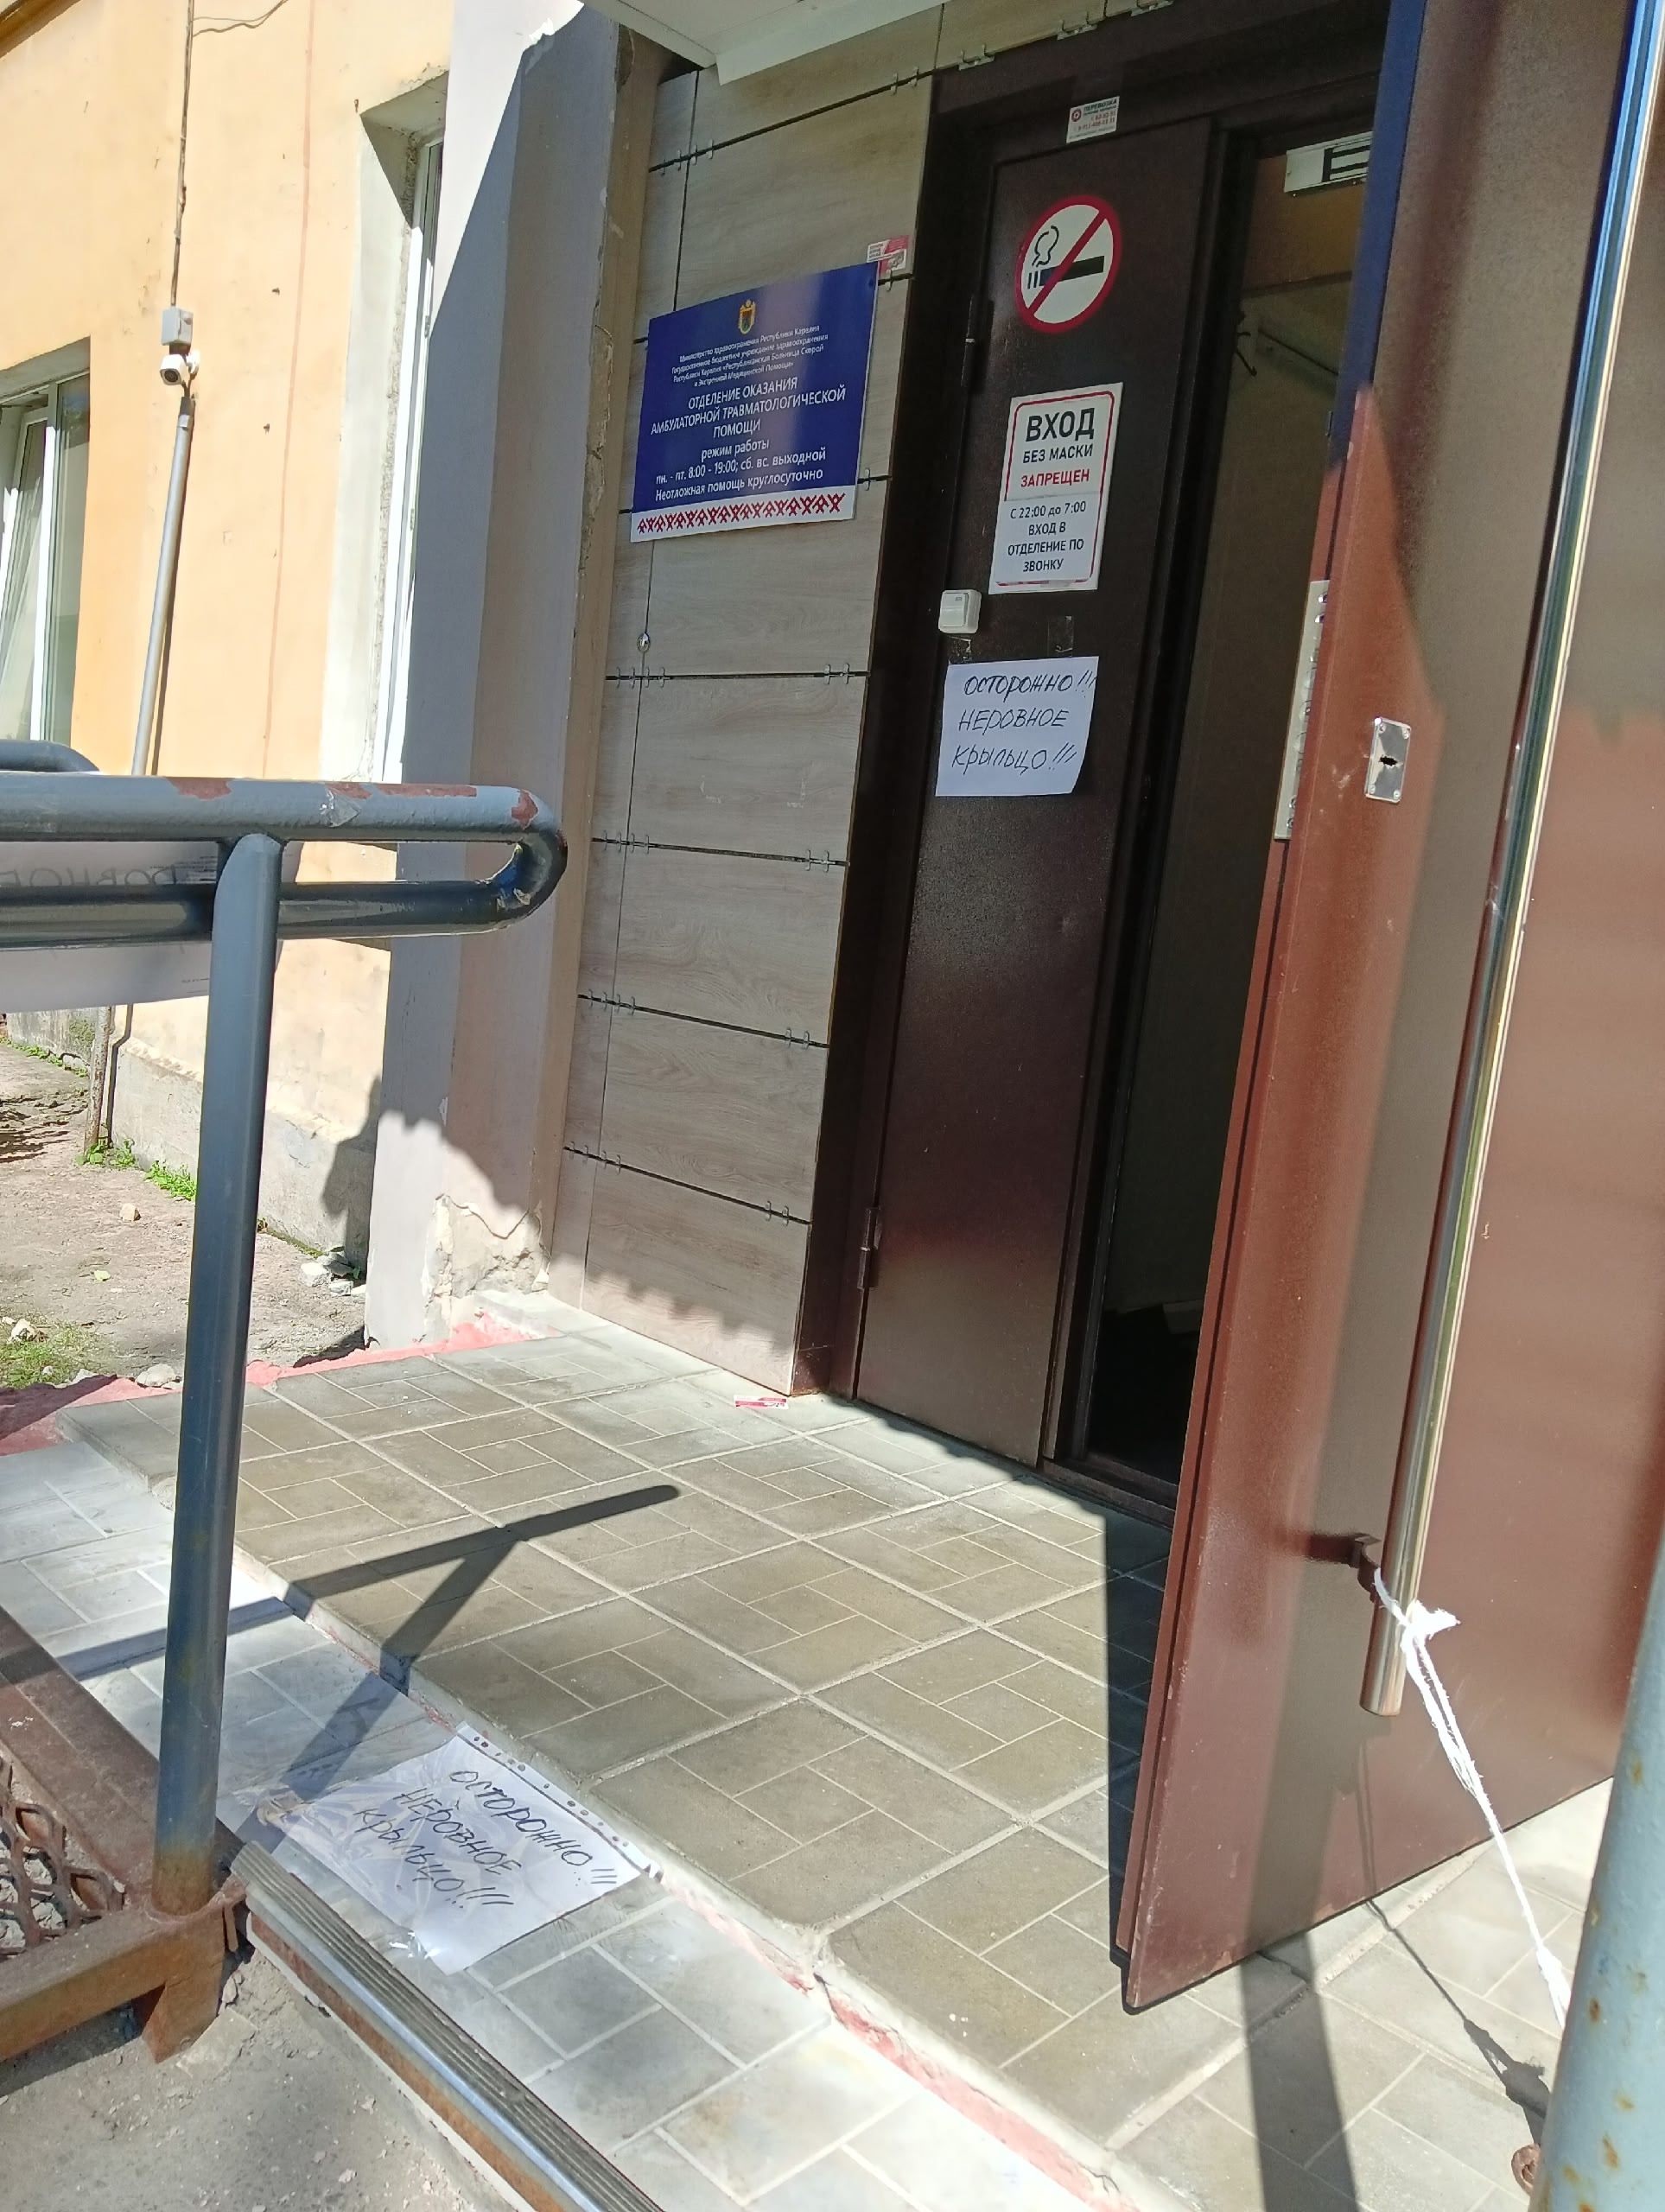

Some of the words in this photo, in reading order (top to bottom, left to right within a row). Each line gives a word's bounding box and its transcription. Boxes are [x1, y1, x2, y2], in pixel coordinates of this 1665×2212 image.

[688, 387, 741, 410] ОТДЕЛЕНИЕ
[742, 377, 798, 397] ОКАЗАНИЯ
[651, 406, 721, 435] АМБУЛАТОРНОЙ
[722, 384, 847, 418] ТРАВМАТОЛОГИЧЕСКОЙ
[713, 418, 761, 439] ПОМОЩИ
[1025, 407, 1095, 442] ВХОД
[701, 444, 733, 463] режим
[734, 437, 770, 456] работы
[1022, 448, 1045, 464] БЕЗ
[1049, 443, 1093, 462] МАСКИ
[655, 474, 668, 486] пн.
[675, 469, 687, 483] пт.
[688, 463, 706, 480] 8:00
[740, 456, 754, 472] сб.
[756, 457, 770, 470] вс.
[772, 447, 826, 467] выходной
[1020, 468, 1090, 488] ЗАПРЕЩЕН
[655, 481, 707, 502] Неотложная
[707, 479, 746, 496] помощь
[747, 468, 824, 490] круглосуточно
[1010, 508, 1017, 519] С
[1018, 505, 1047, 519] 22:00
[1047, 505, 1062, 518] до
[1064, 500, 1087, 515] 7:00
[1027, 523, 1057, 537] ВХОД
[1058, 521, 1066, 533] В
[1007, 540, 1066, 556] ОТДЕЛЕНИЕ
[1069, 538, 1084, 550] ПО
[1022, 558, 1064, 573] ЗВОНКУ
[958, 707, 1070, 736] НЕРОВНОЕ
[394, 1788, 523, 1875] НЕРОВНОЕ
